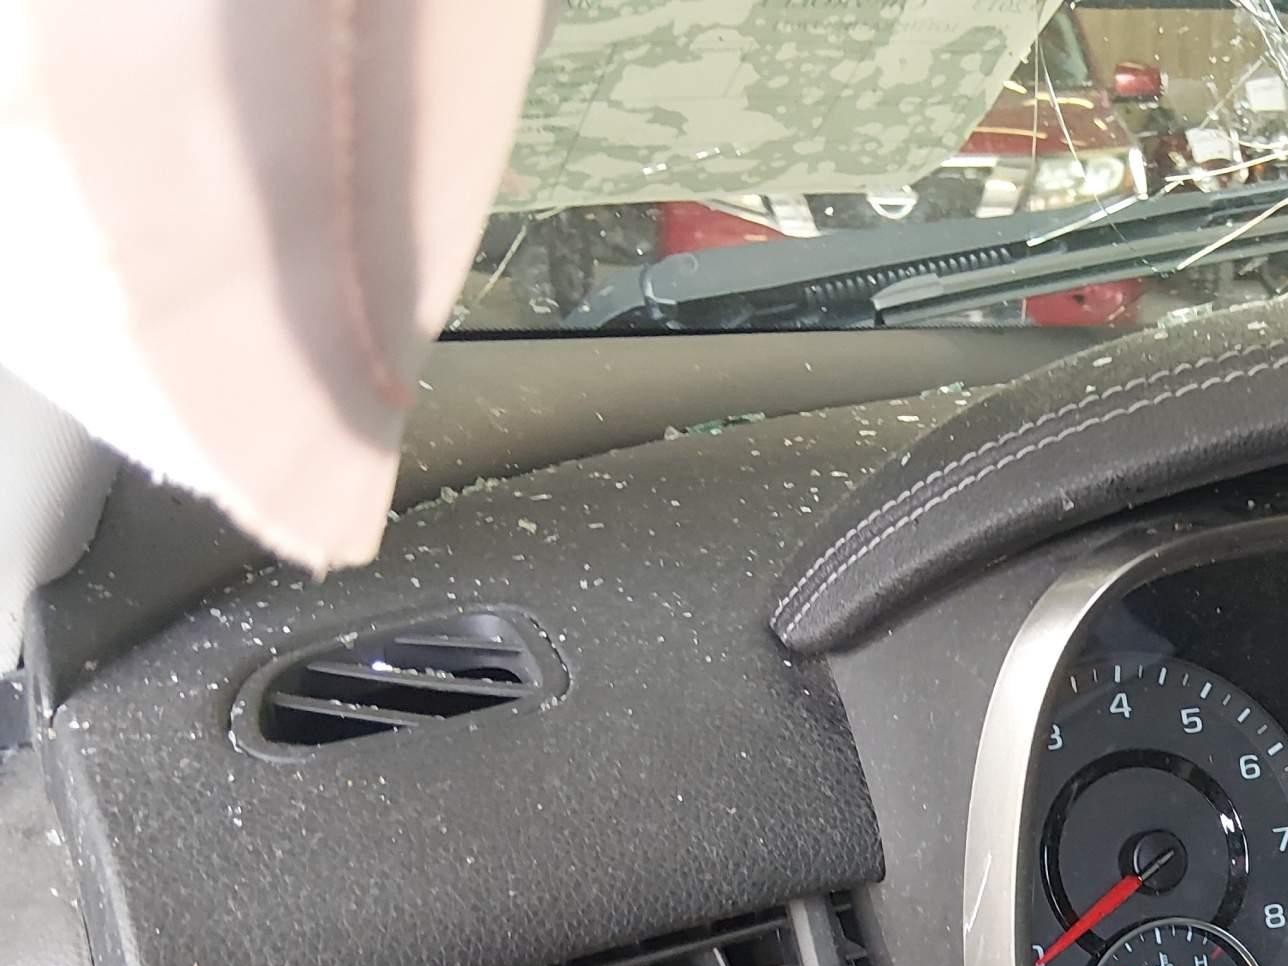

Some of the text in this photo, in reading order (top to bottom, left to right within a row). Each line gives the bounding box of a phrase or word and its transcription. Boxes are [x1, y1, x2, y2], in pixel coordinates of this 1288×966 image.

[1109, 692, 1132, 719] 4
[1180, 706, 1203, 734] 5
[1047, 723, 1063, 751] 3
[1238, 754, 1262, 780] 6
[1263, 903, 1286, 929] 8
